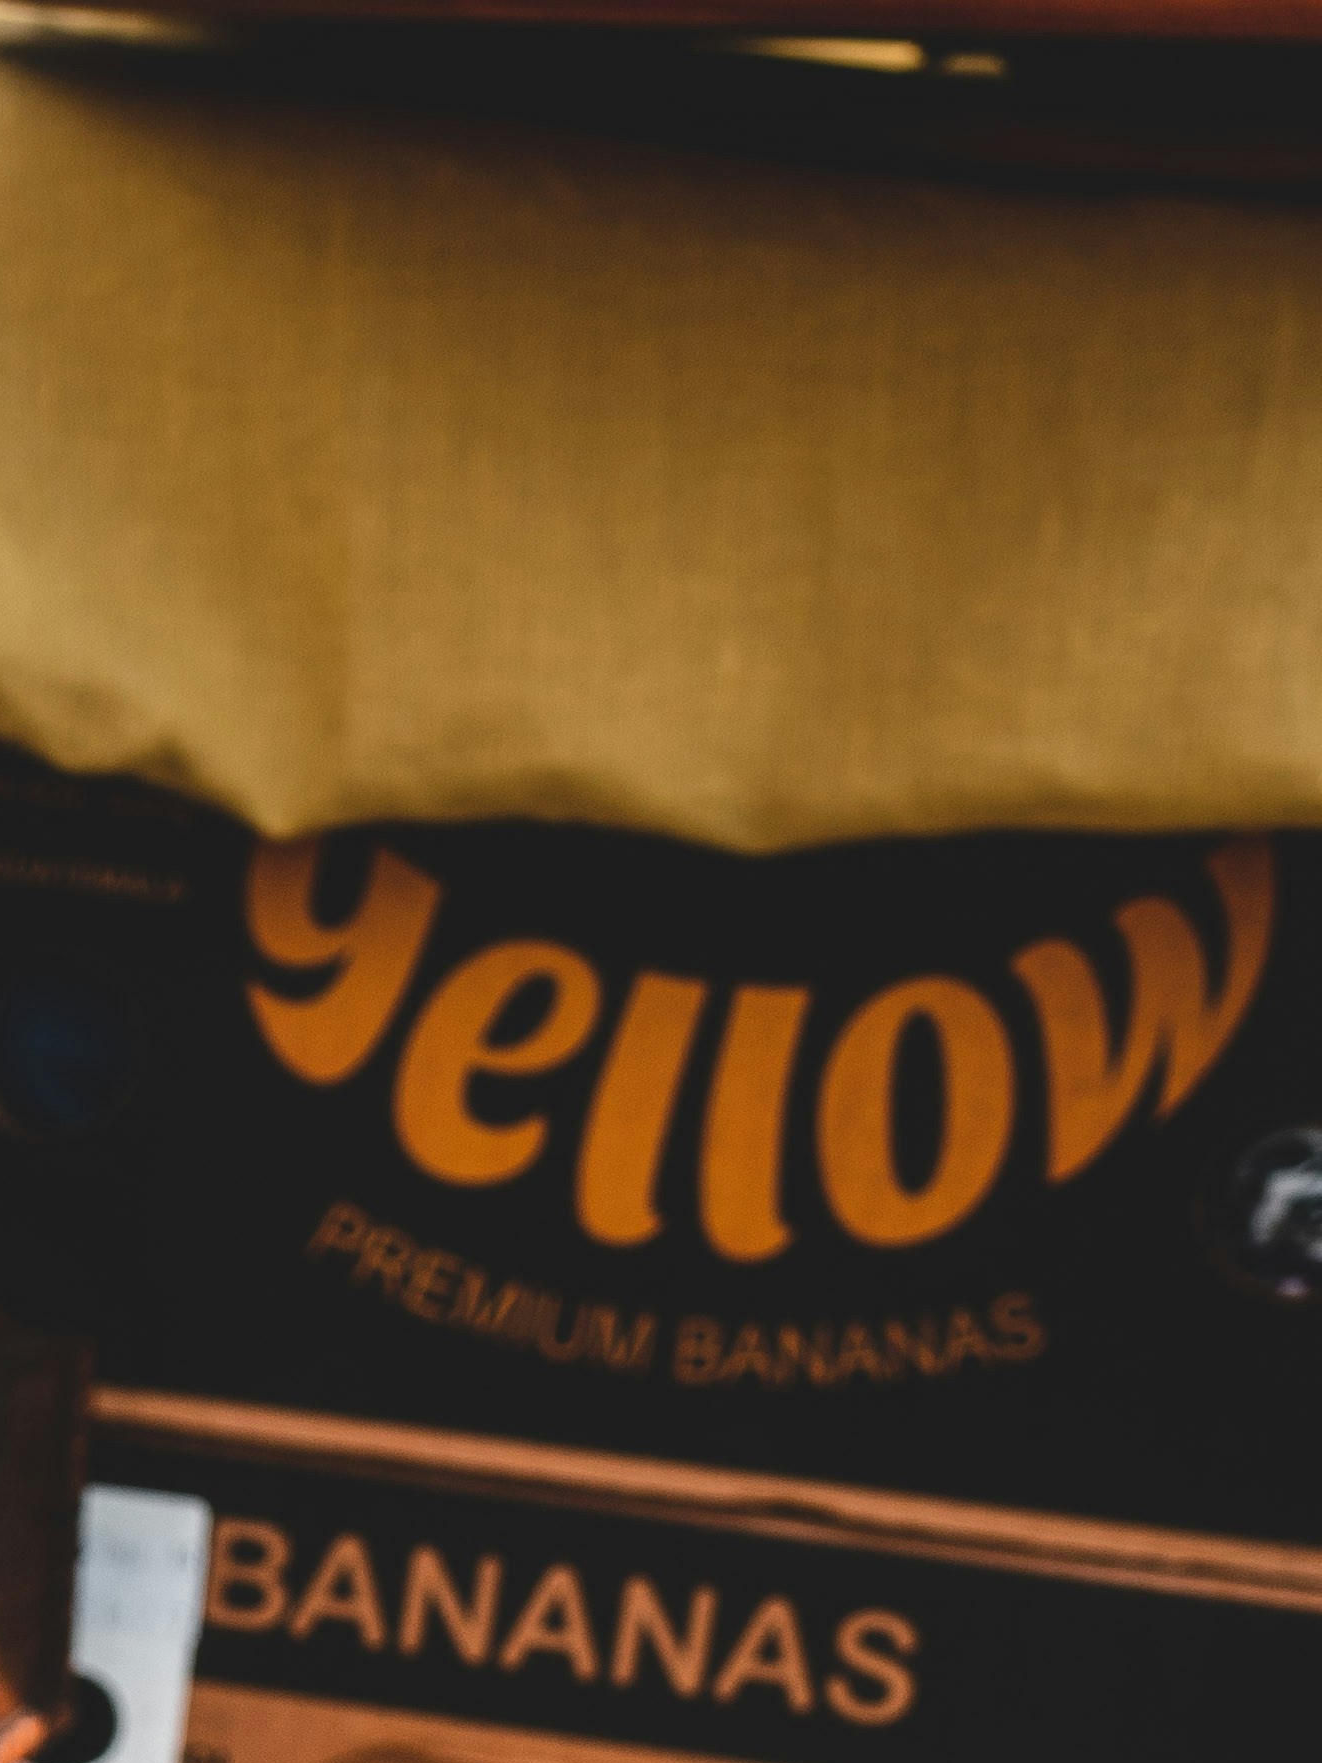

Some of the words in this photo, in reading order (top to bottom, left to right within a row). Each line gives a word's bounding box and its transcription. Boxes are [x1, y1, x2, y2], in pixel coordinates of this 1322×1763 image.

[307, 1203, 657, 1372] PREMIUM
[672, 1292, 1047, 1387] BANANAS
[205, 1514, 920, 1728] BANANAS
